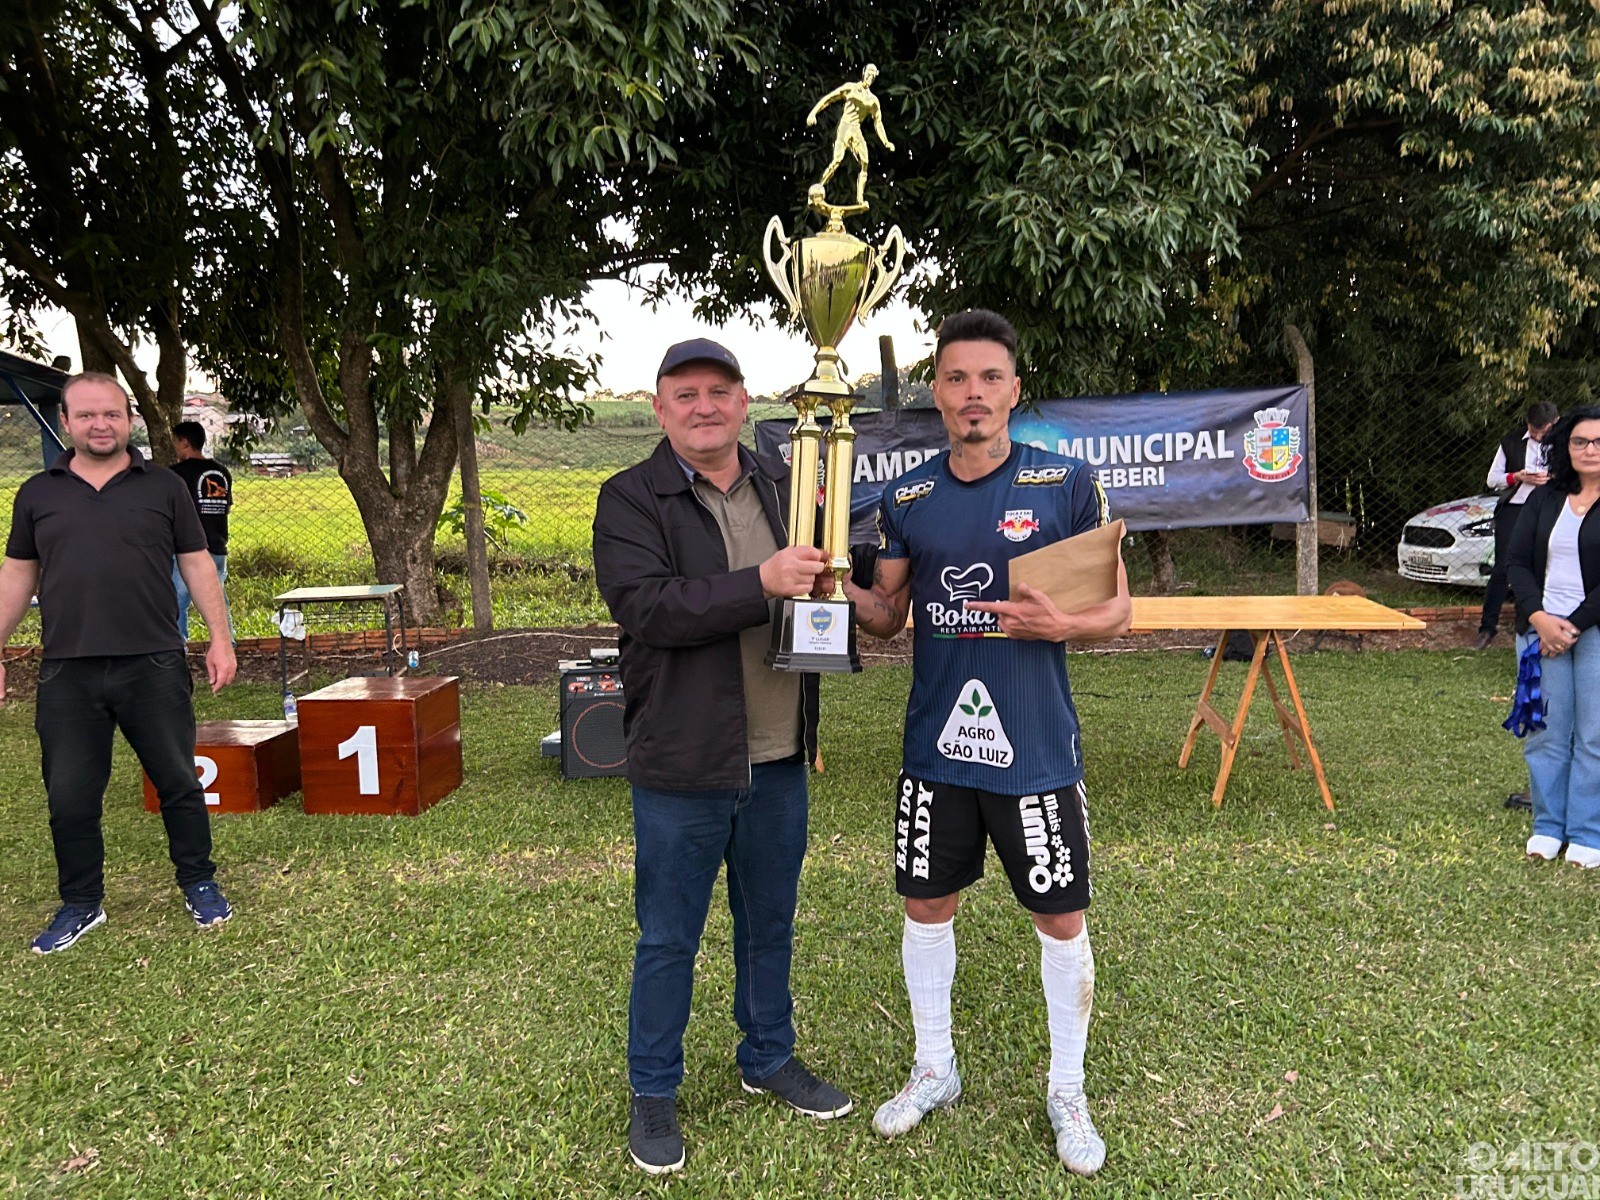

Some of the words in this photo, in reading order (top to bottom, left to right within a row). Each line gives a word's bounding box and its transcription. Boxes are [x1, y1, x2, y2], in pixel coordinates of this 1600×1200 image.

[853, 449, 939, 483] AMP
[1057, 430, 1234, 465] MUNICIPAL
[1018, 468, 1068, 480] CHICO
[896, 481, 935, 500] CHICO
[1098, 466, 1165, 488] EBERI
[943, 740, 973, 759] SÃO
[979, 748, 1009, 765] LUIZ
[957, 726, 996, 742] AGRO
[194, 755, 220, 805] 2
[338, 726, 379, 795] 1
[899, 778, 914, 817] DO
[1043, 793, 1062, 833] mais
[896, 819, 910, 872] BAR
[912, 781, 934, 880] BADY
